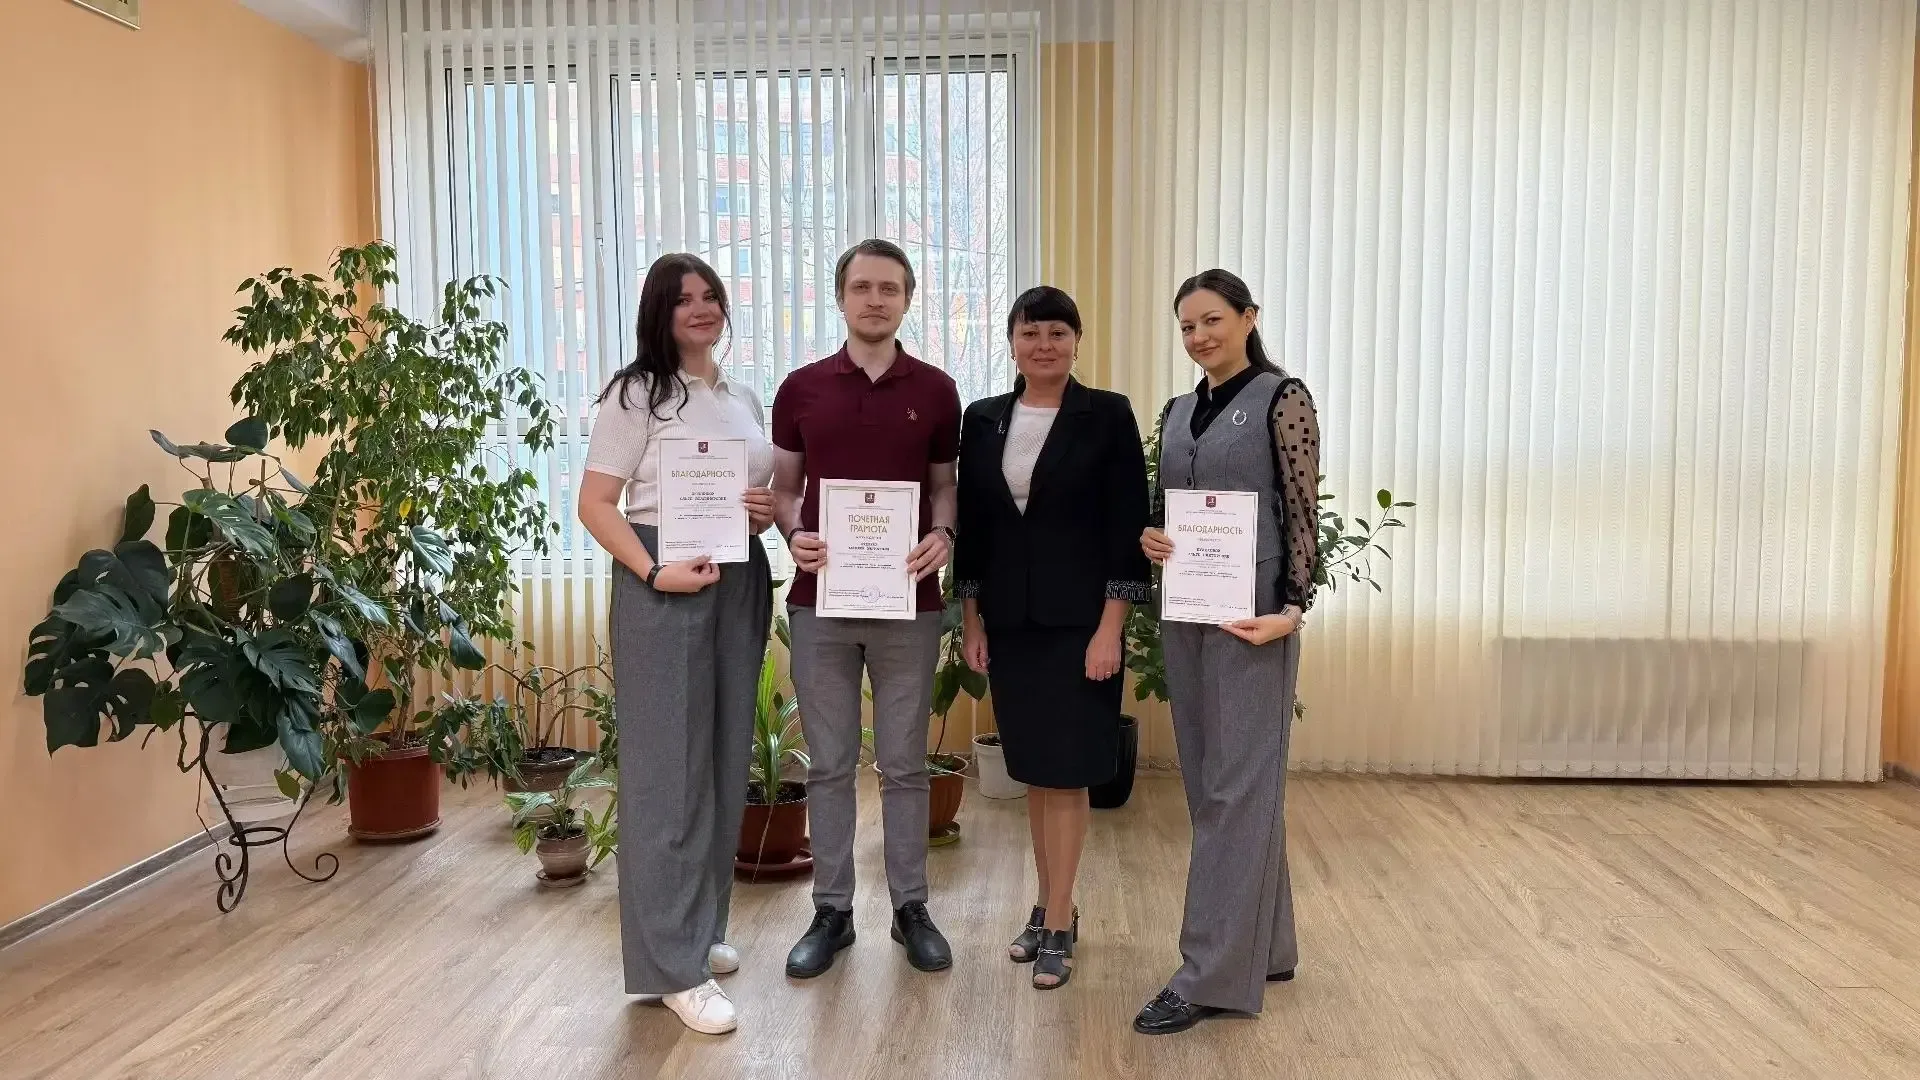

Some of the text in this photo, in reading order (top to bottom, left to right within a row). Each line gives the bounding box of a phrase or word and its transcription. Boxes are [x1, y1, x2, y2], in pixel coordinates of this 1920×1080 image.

[671, 470, 736, 478] БЛАГОДАРНОСТЬ
[848, 514, 890, 524] ПОЧЕТНАЯ
[850, 524, 888, 533] ГРАМОТА
[1178, 525, 1243, 535] БЛАГОДАРНОСТЬ
